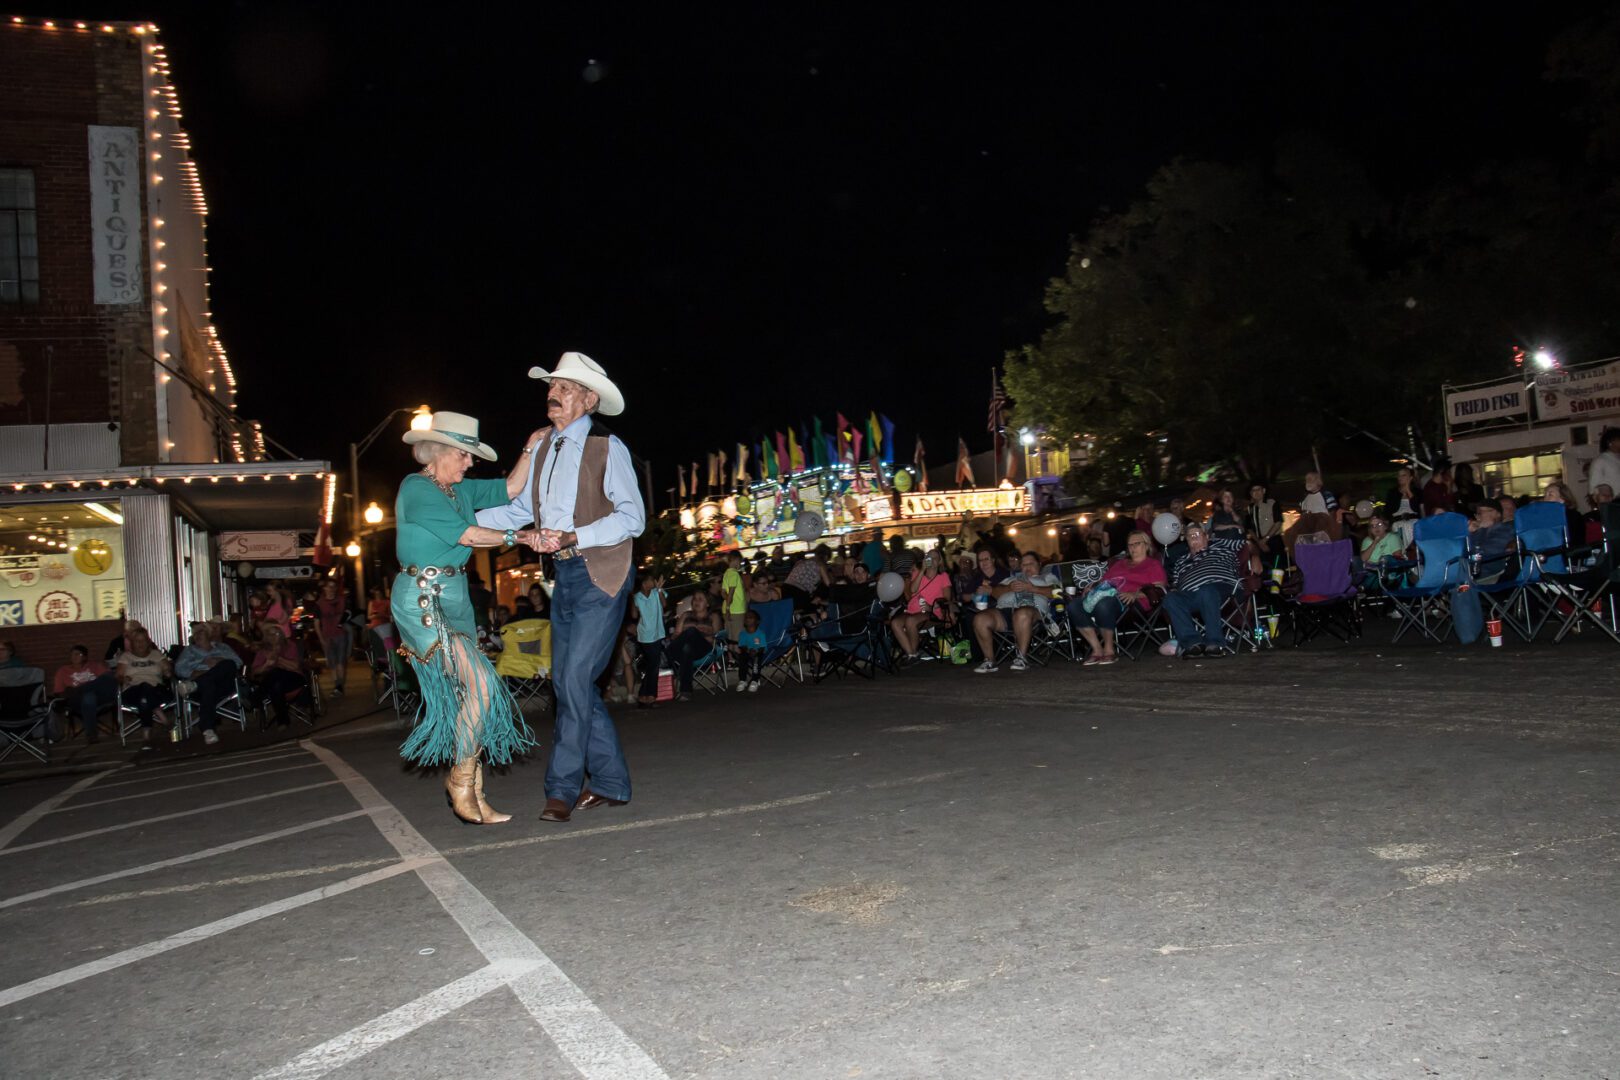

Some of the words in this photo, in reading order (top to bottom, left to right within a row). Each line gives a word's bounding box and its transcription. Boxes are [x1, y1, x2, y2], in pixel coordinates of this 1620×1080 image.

[103, 141, 129, 289] ANTIQUES
[1454, 397, 1490, 417] FRIED
[1491, 391, 1520, 411] FISH
[919, 495, 957, 513] DAT
[0, 602, 22, 626] RC
